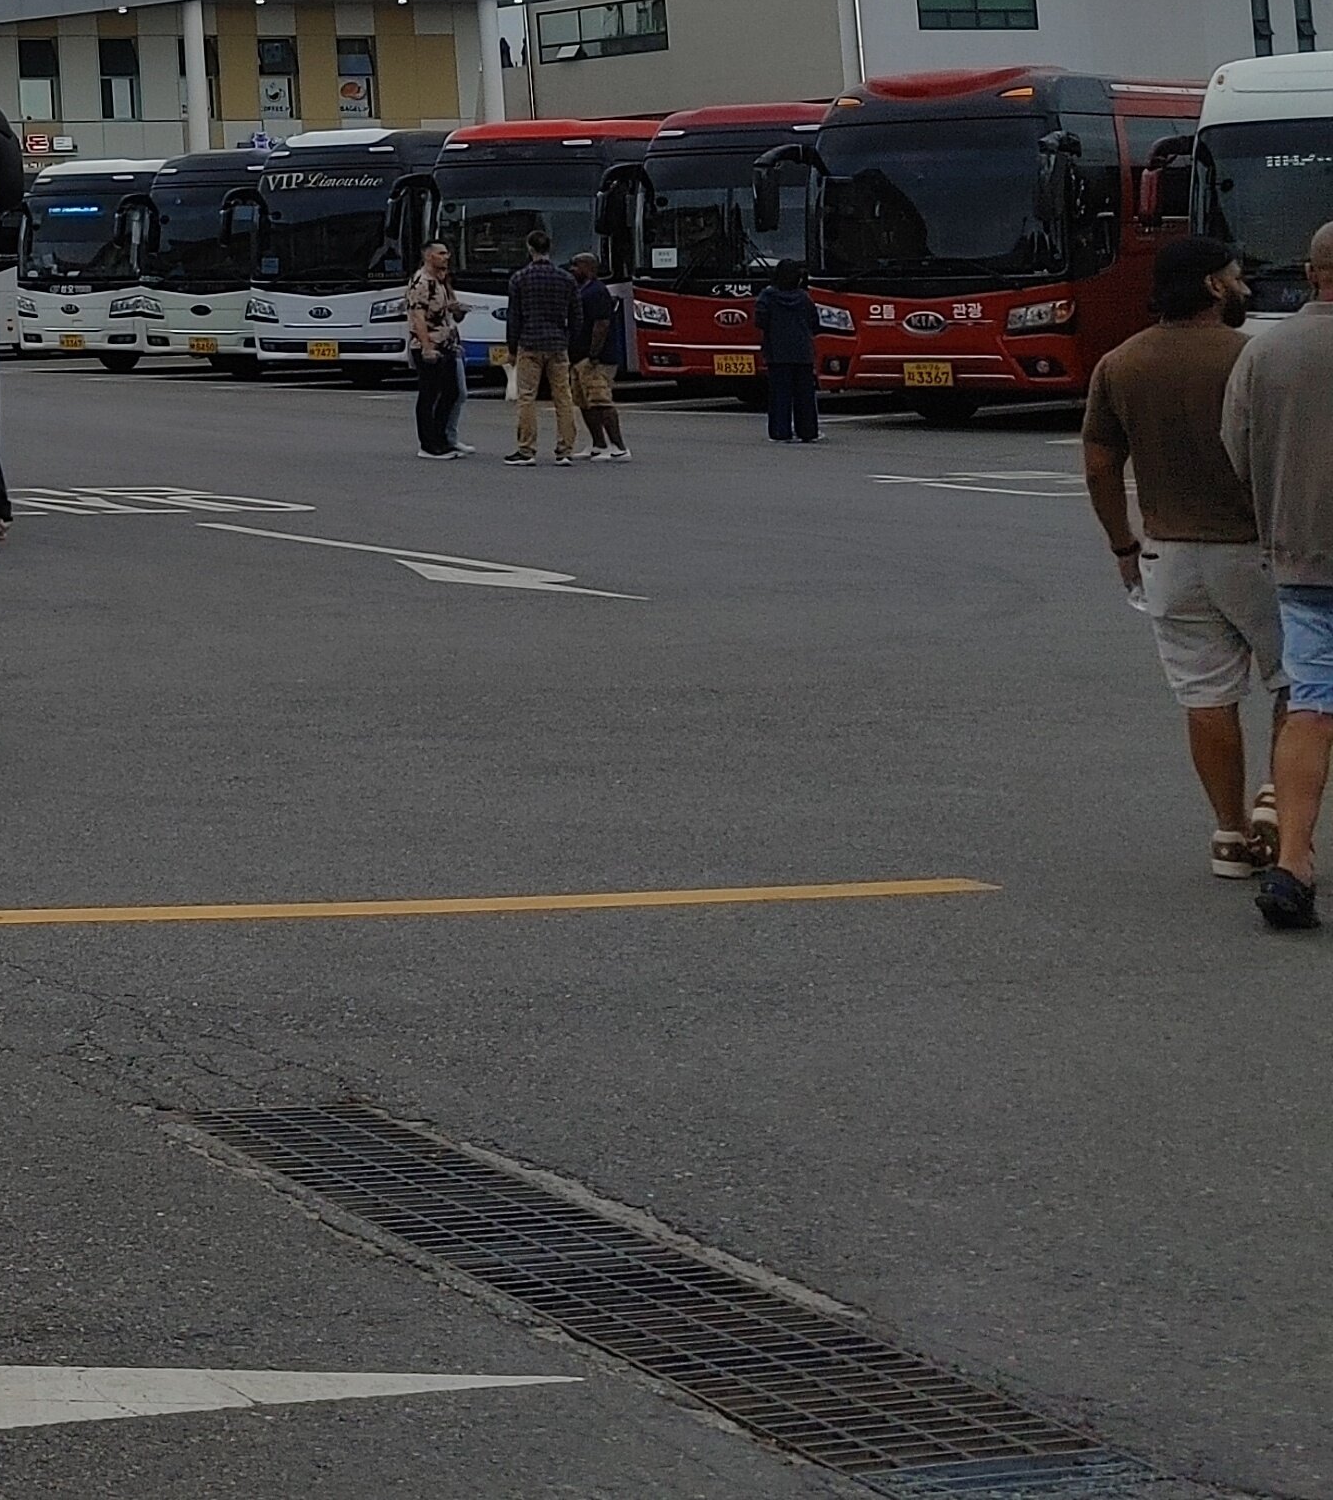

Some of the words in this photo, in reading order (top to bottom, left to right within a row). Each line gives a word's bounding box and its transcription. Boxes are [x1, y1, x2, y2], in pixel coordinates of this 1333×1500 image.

[267, 172, 304, 192] VIP
[305, 171, 384, 189] Limousine
[312, 307, 331, 318] KIA
[952, 303, 983, 319] 관광
[719, 312, 742, 324] KIA
[910, 315, 938, 327] KIA
